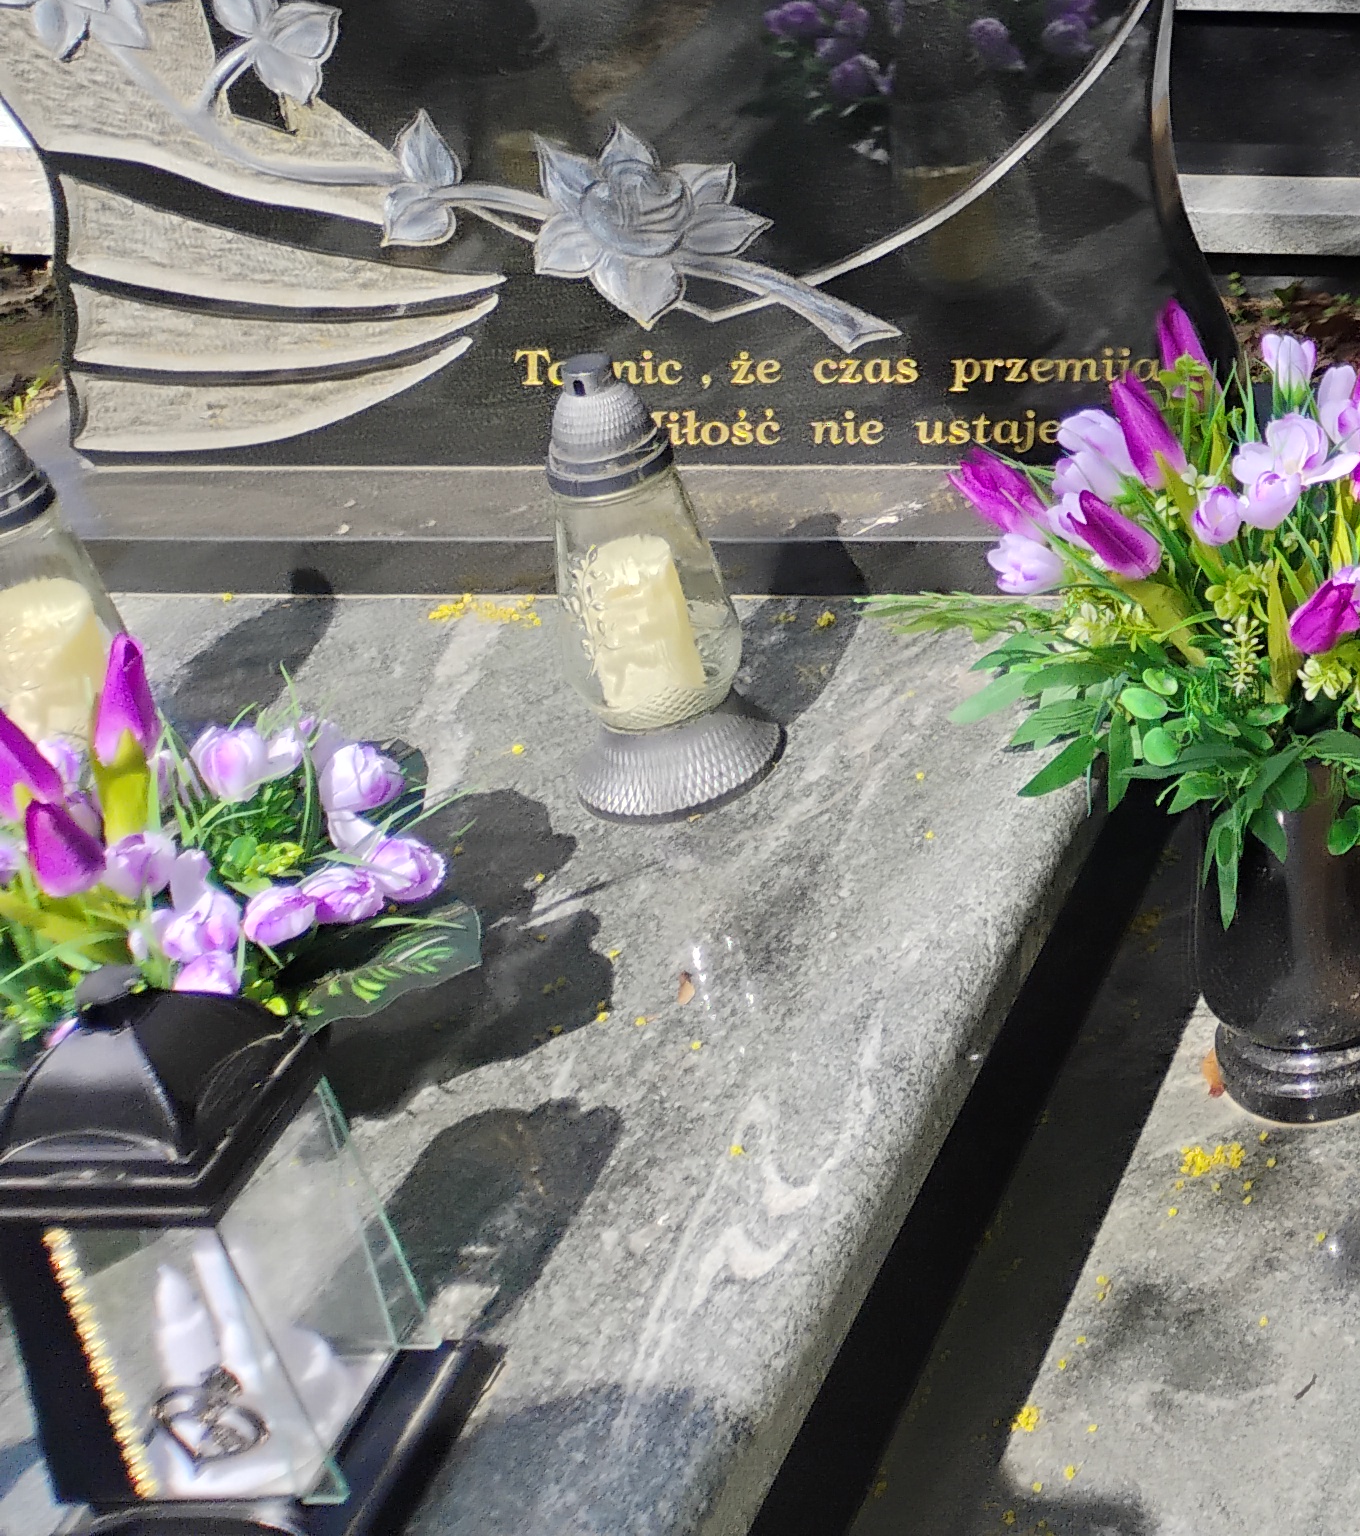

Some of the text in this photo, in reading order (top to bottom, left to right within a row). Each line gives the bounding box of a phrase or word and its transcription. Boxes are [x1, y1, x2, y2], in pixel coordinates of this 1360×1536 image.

[730, 350, 782, 384] że
[813, 357, 919, 384] czas
[651, 408, 781, 446] iłość
[811, 410, 885, 444] nie
